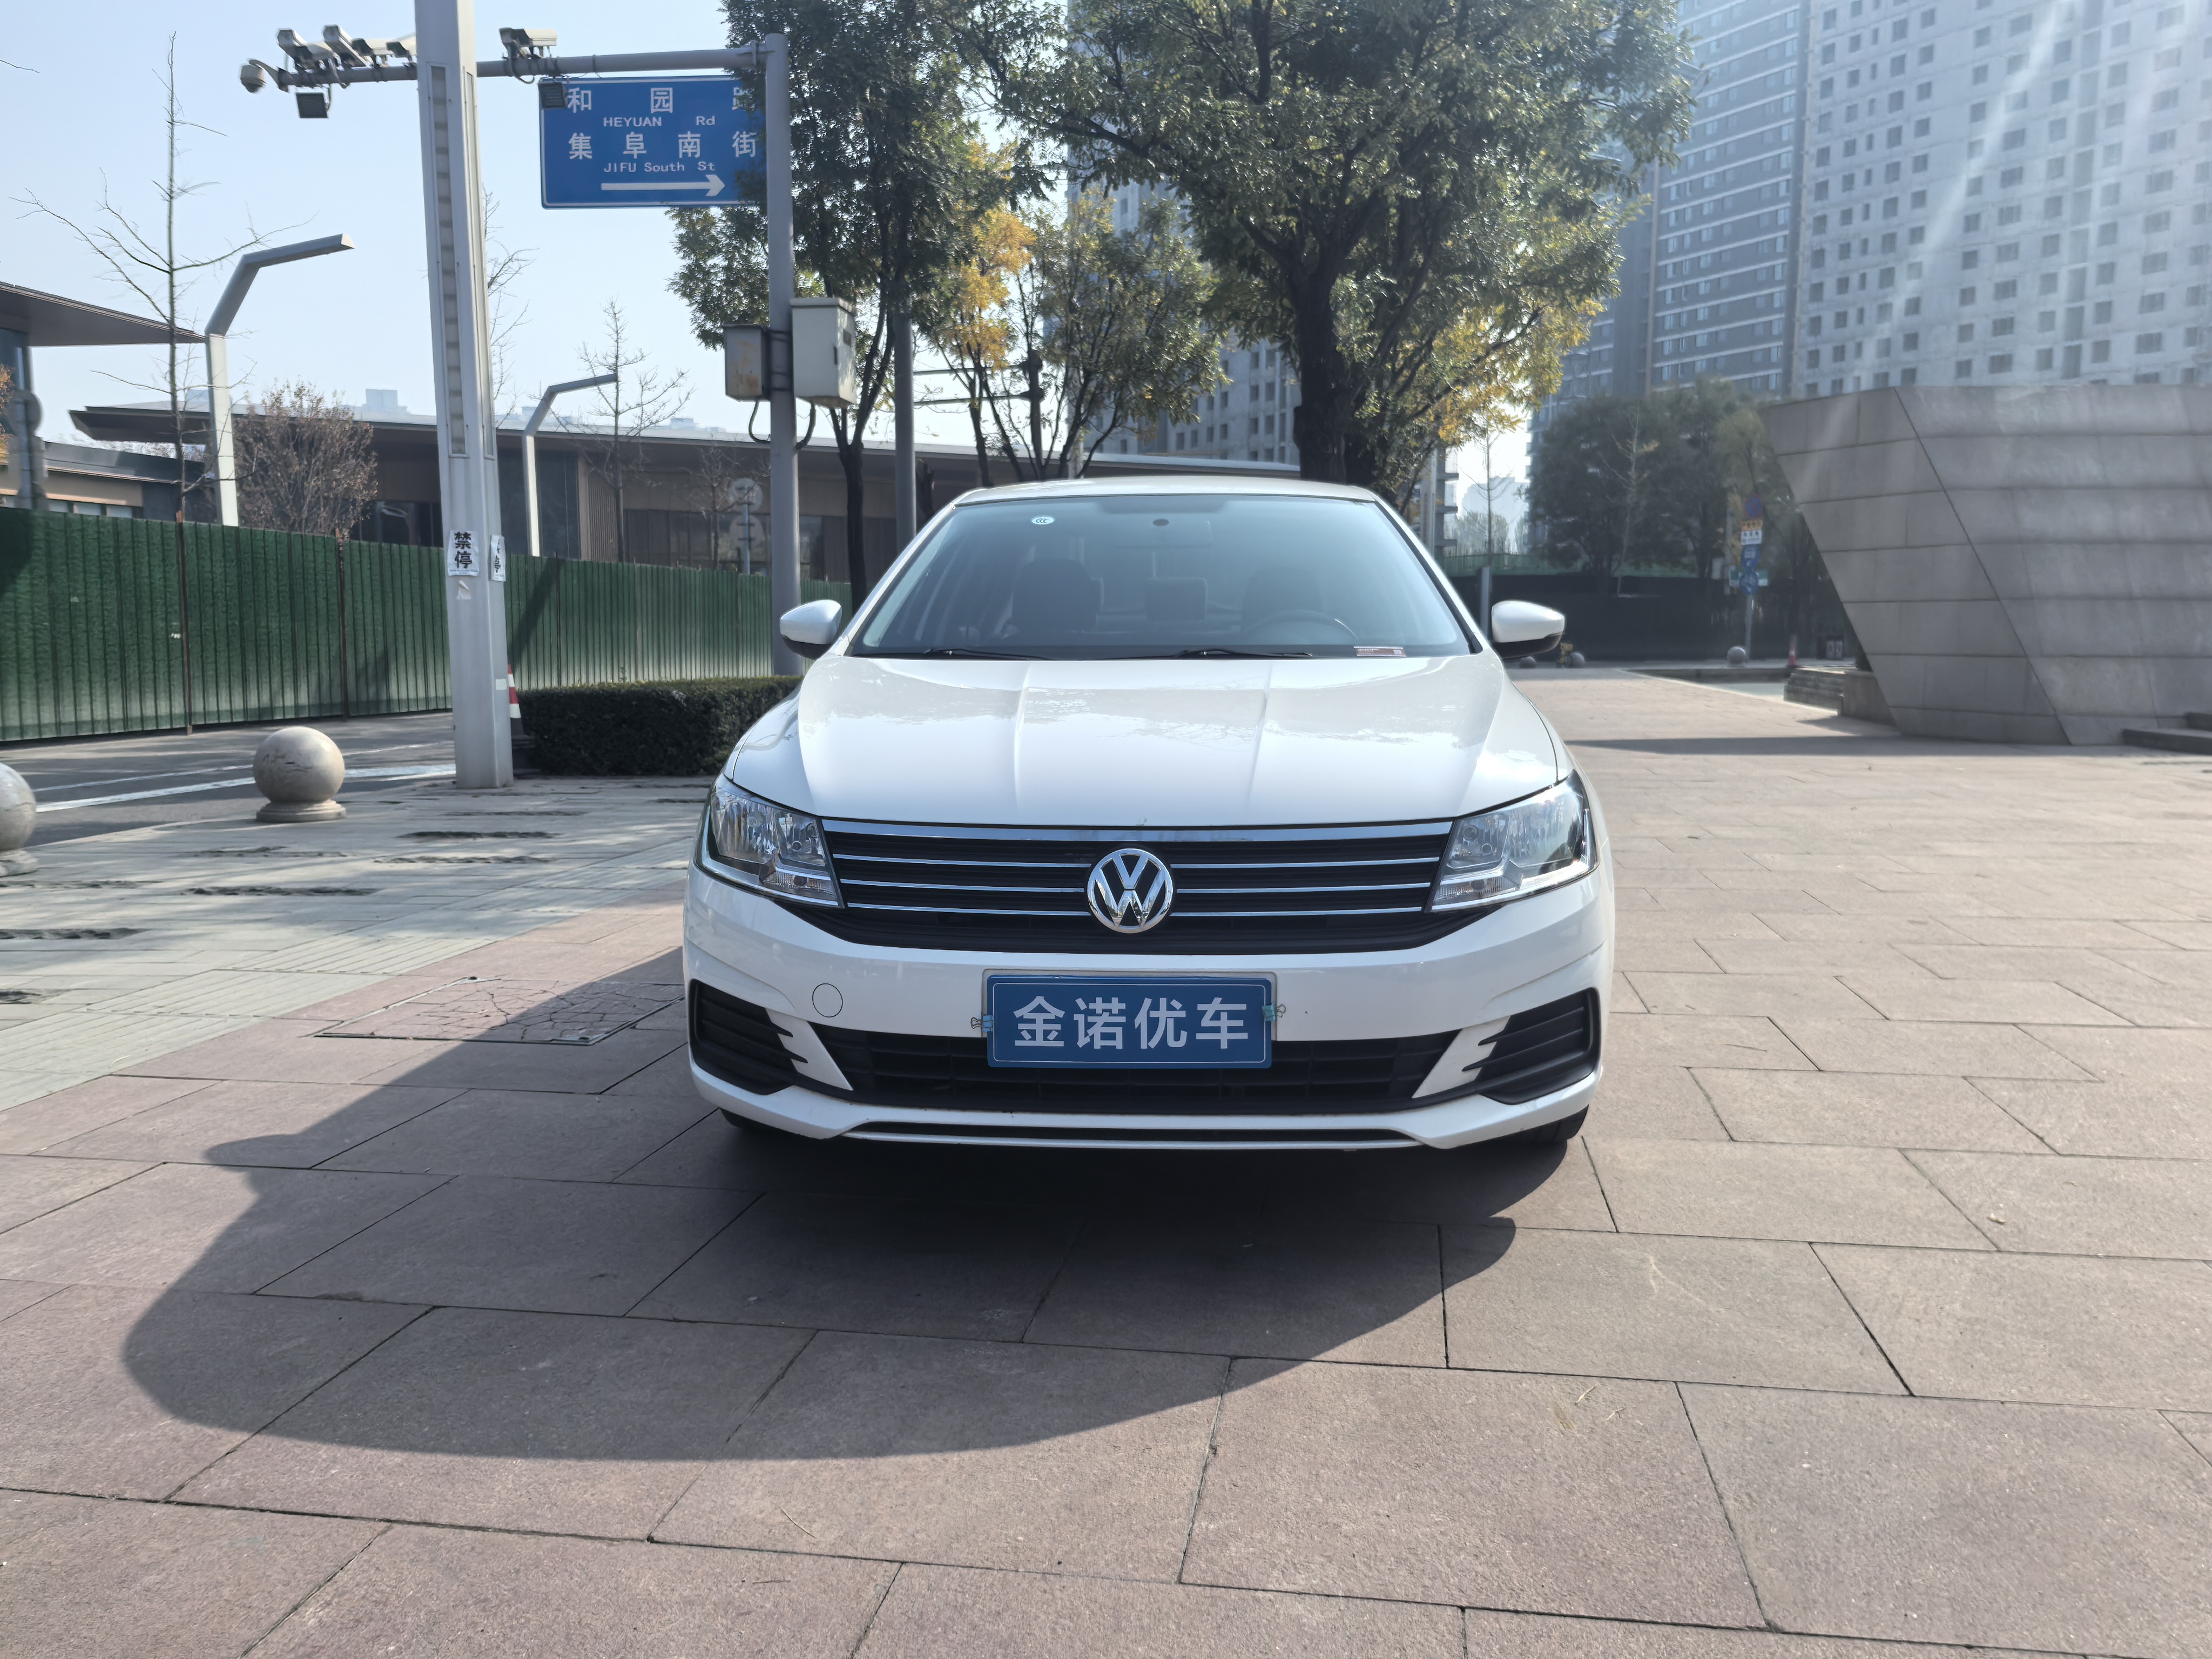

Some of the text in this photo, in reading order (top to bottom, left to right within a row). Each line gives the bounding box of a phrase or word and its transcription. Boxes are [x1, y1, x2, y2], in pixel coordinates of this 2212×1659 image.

[603, 116, 716, 127] HEYUAN Rd
[568, 131, 756, 159] 集阜南街
[603, 161, 716, 173] JIFU South St
[454, 531, 473, 569] 禁停
[1013, 996, 1248, 1049] 金诺优车
